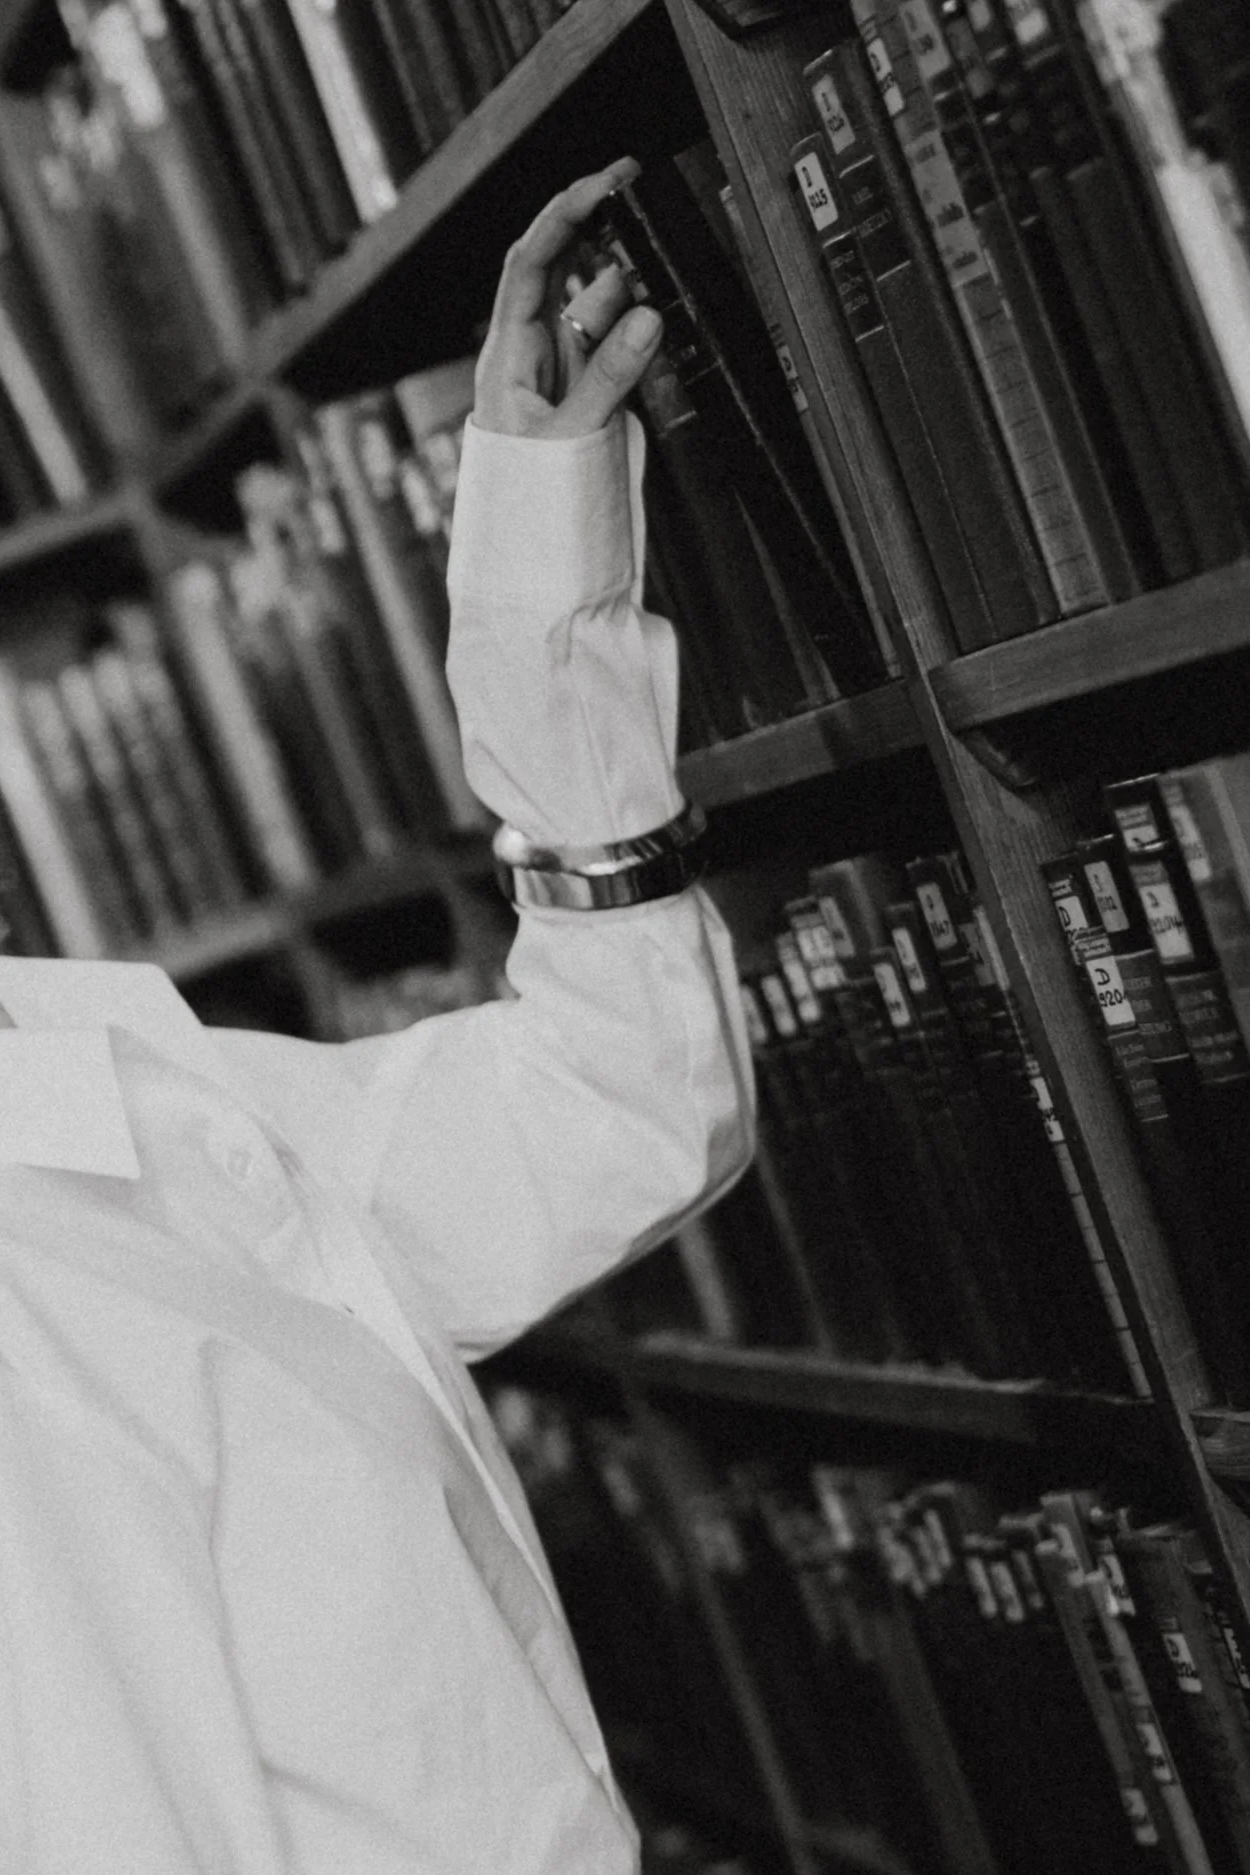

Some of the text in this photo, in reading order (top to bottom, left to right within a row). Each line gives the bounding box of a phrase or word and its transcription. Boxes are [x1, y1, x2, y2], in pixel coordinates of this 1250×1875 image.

[1058, 905, 1071, 926] D
[1094, 967, 1111, 986] D
[1098, 988, 1126, 1008] 920
